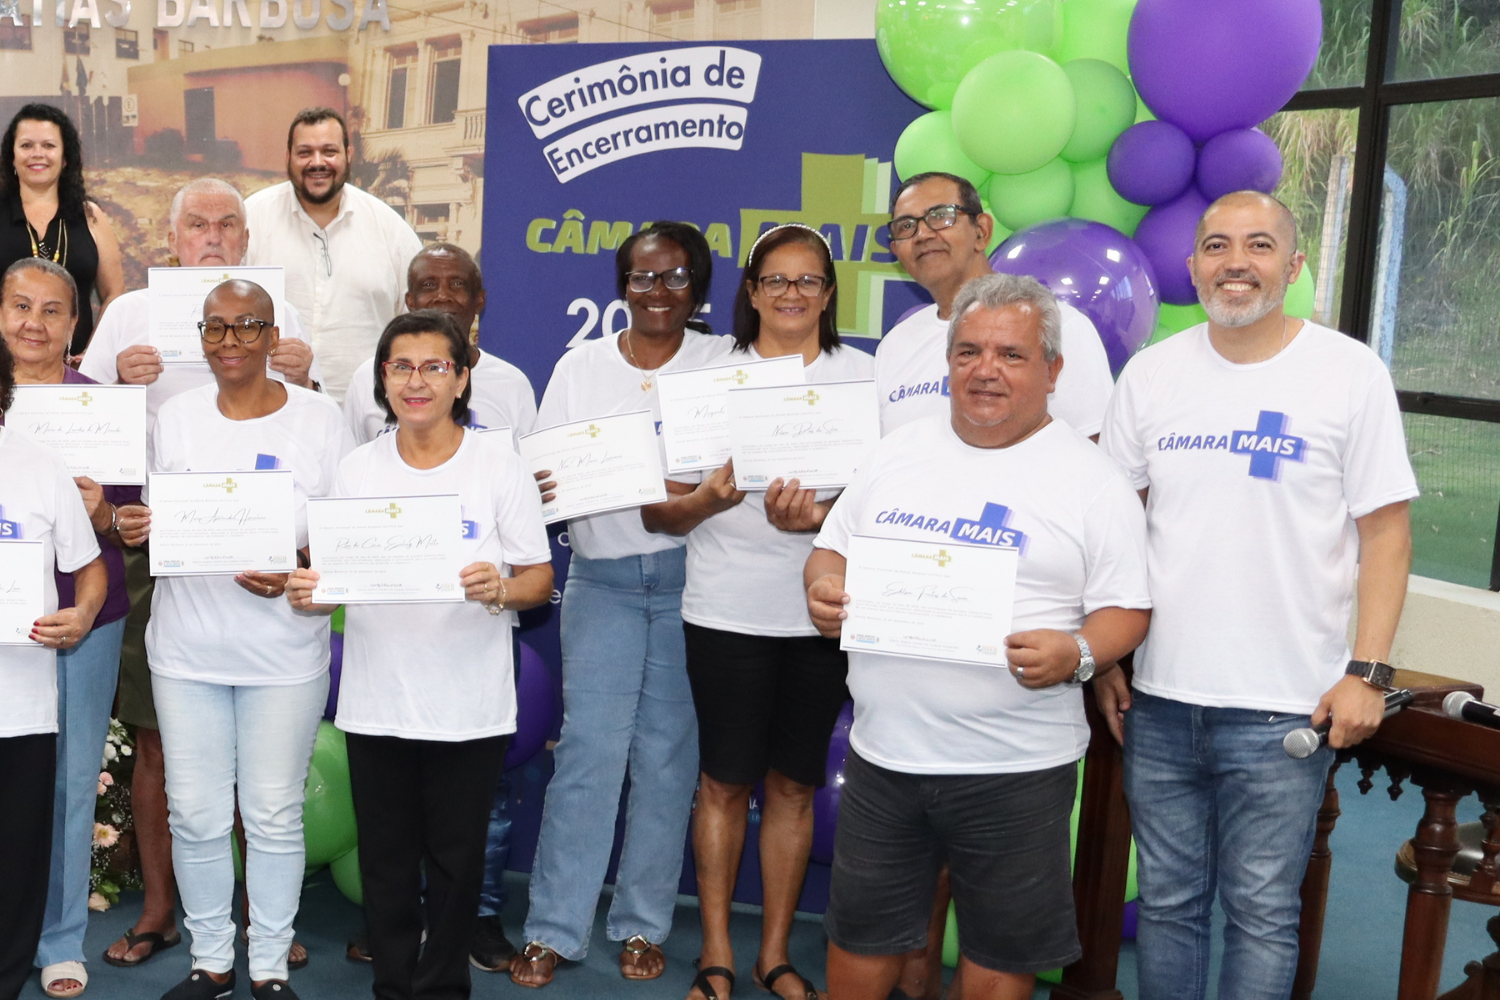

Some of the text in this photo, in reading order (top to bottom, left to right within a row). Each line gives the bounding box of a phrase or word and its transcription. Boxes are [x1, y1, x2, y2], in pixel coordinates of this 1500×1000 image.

[524, 50, 745, 127] Cerimônia de
[547, 113, 744, 175] Encerramento
[1158, 432, 1297, 456] CÂMARA MAIS
[875, 508, 1016, 546] CÂMARA MAIS
